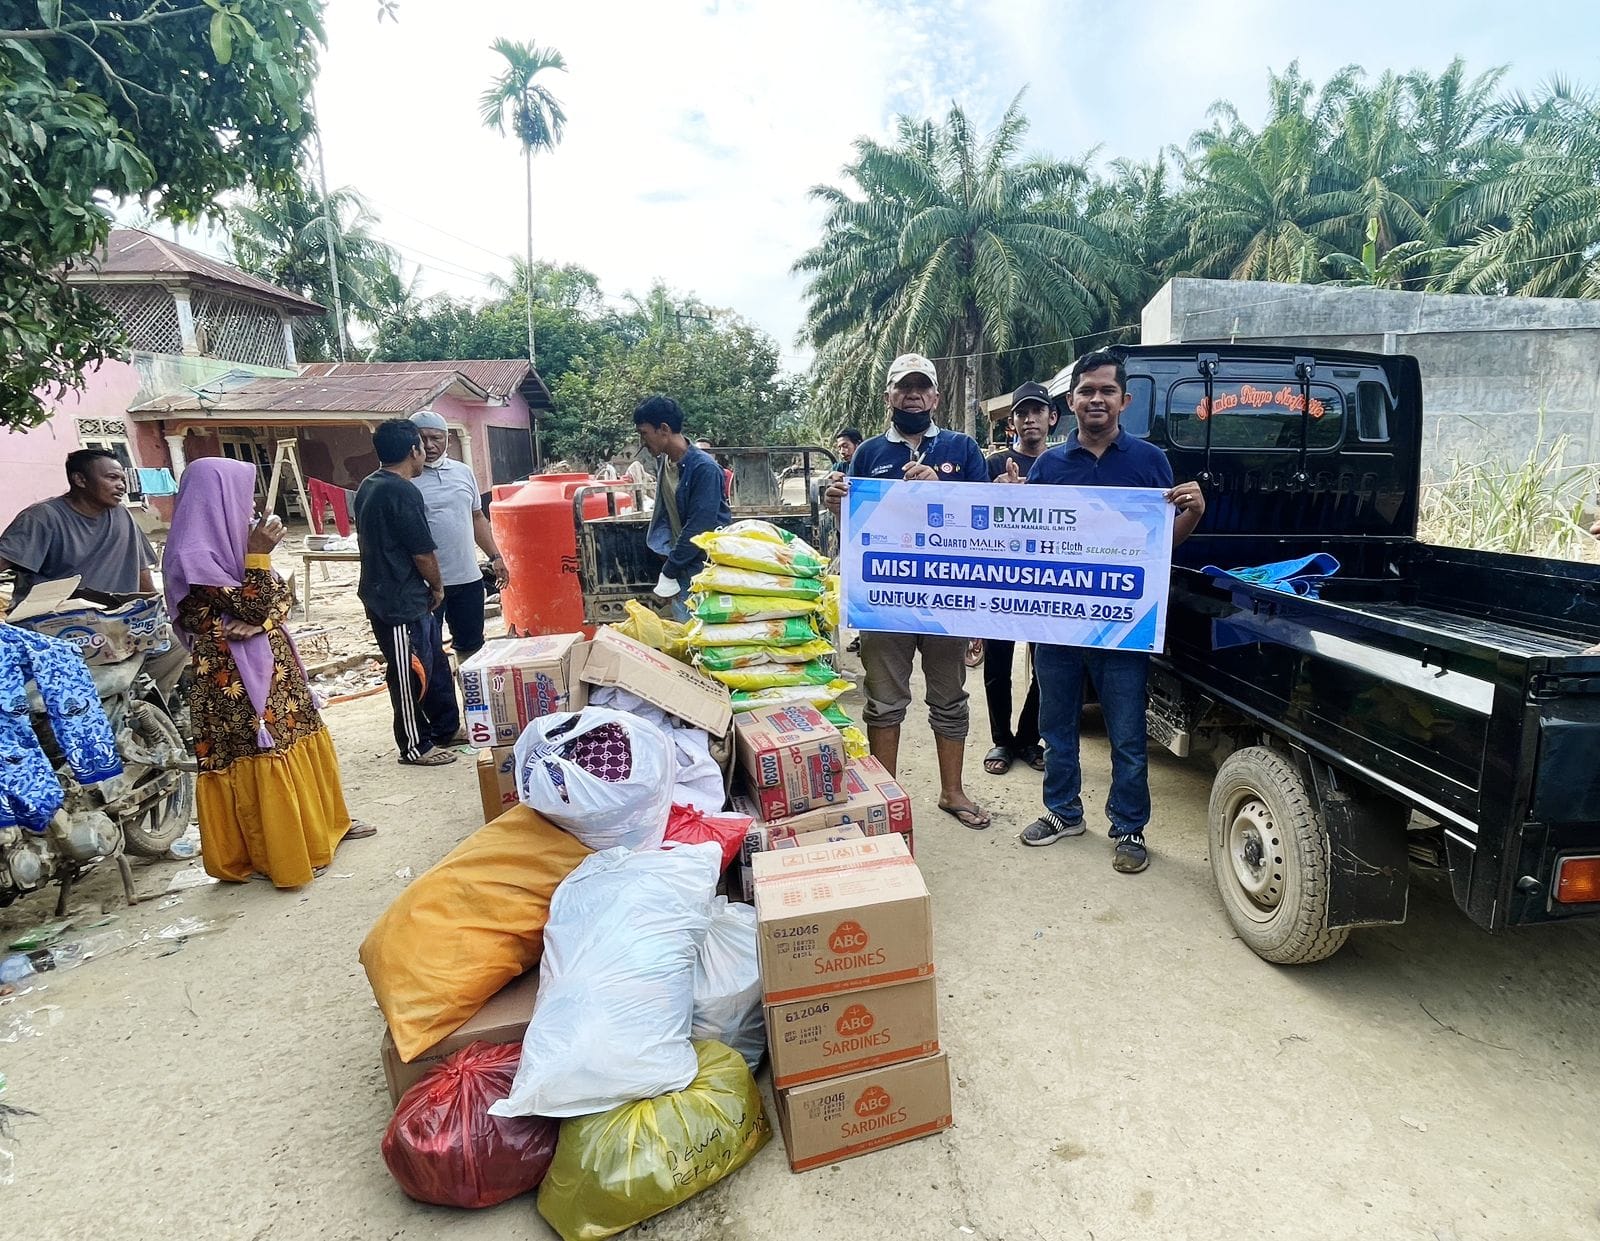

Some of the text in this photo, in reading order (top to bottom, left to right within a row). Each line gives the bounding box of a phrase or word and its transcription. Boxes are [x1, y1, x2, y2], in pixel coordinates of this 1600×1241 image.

[1006, 506, 1043, 524] YMI
[970, 538, 1006, 549] MALIK
[1061, 541, 1083, 552] Cloth
[871, 558, 1136, 592] MISI KEMANUSIAAN ITS
[869, 589, 928, 607] UNTUK
[931, 593, 977, 609] ACEH
[990, 597, 1087, 618] SUMATERA
[1090, 603, 1135, 621] 2025
[462, 671, 481, 705] 62988
[535, 672, 551, 716] Sedaa
[472, 722, 490, 743] 40
[762, 755, 779, 786] 20030
[818, 743, 834, 802] Sedaap
[769, 800, 787, 819] 40
[793, 801, 804, 812] 9
[889, 802, 906, 822] 40
[832, 932, 866, 949] ABC
[814, 947, 886, 975] SARDINES
[785, 1002, 830, 1023] 612046
[840, 1014, 873, 1032] ABC
[822, 1027, 891, 1058] SARDINES
[858, 1094, 889, 1114] ABC
[840, 1106, 908, 1139] SARDINES
